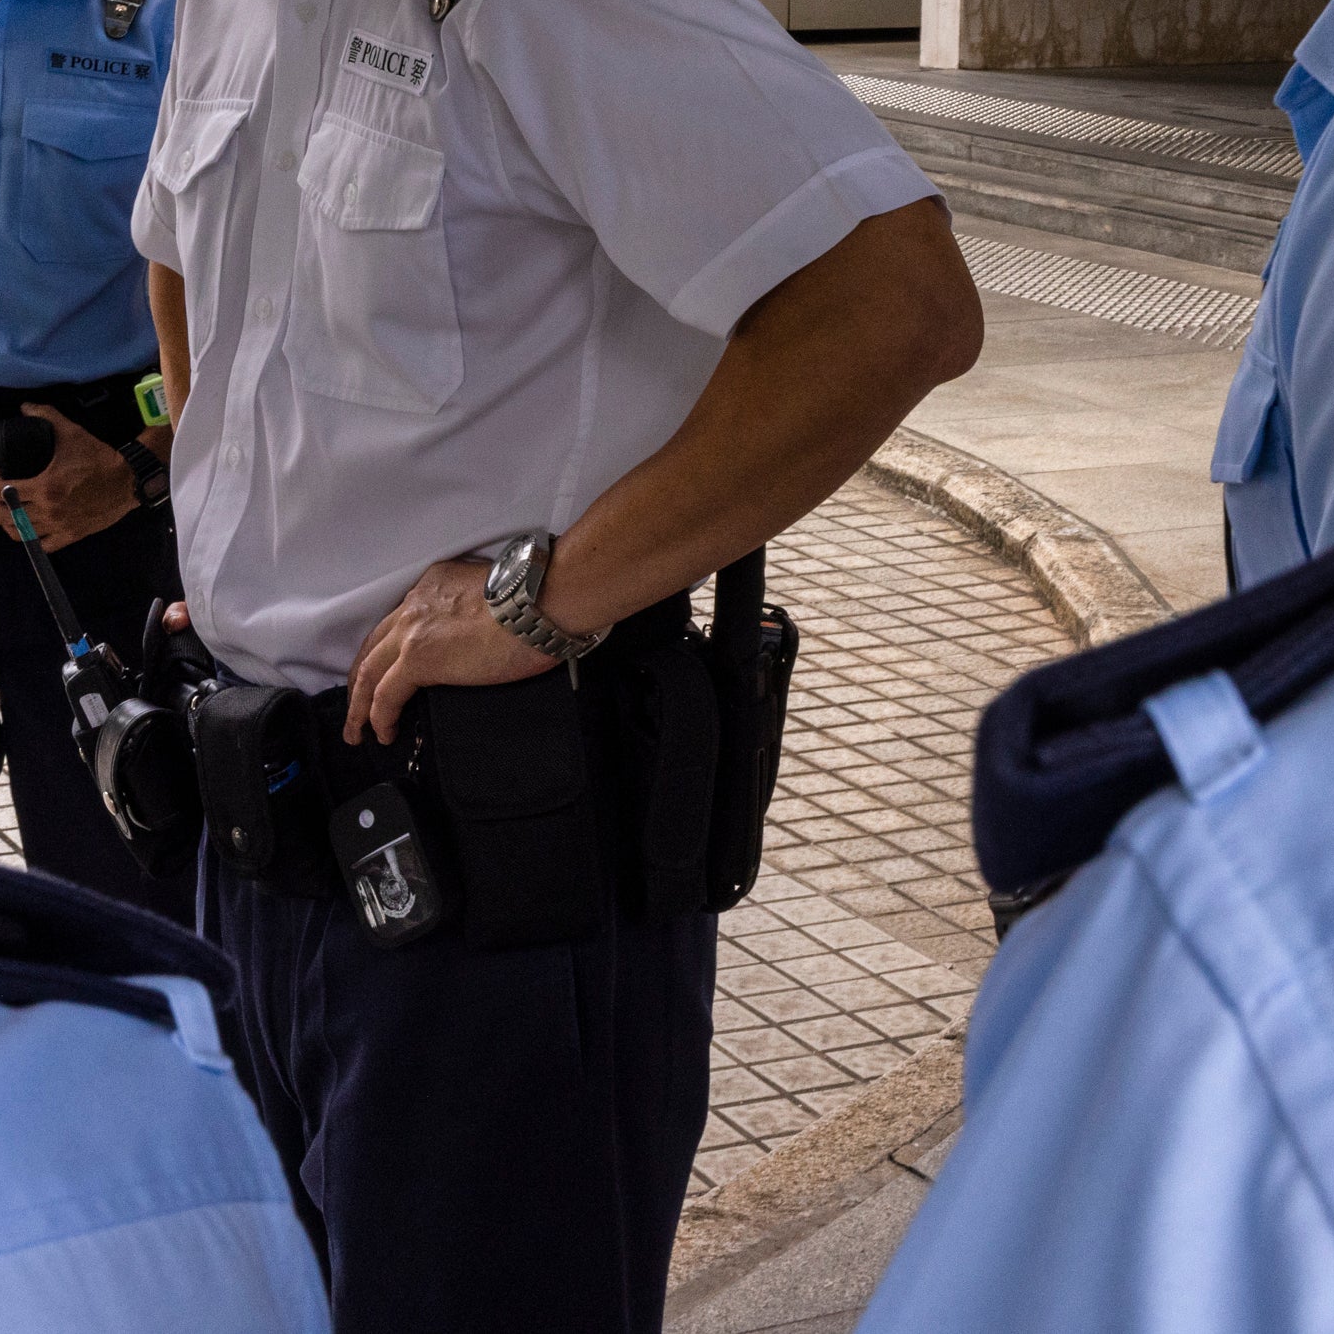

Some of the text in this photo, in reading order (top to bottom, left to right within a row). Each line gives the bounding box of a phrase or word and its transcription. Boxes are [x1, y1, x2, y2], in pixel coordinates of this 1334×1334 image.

[70, 55, 130, 75] POLICE
[348, 36, 427, 86] 警 POLICE 察
